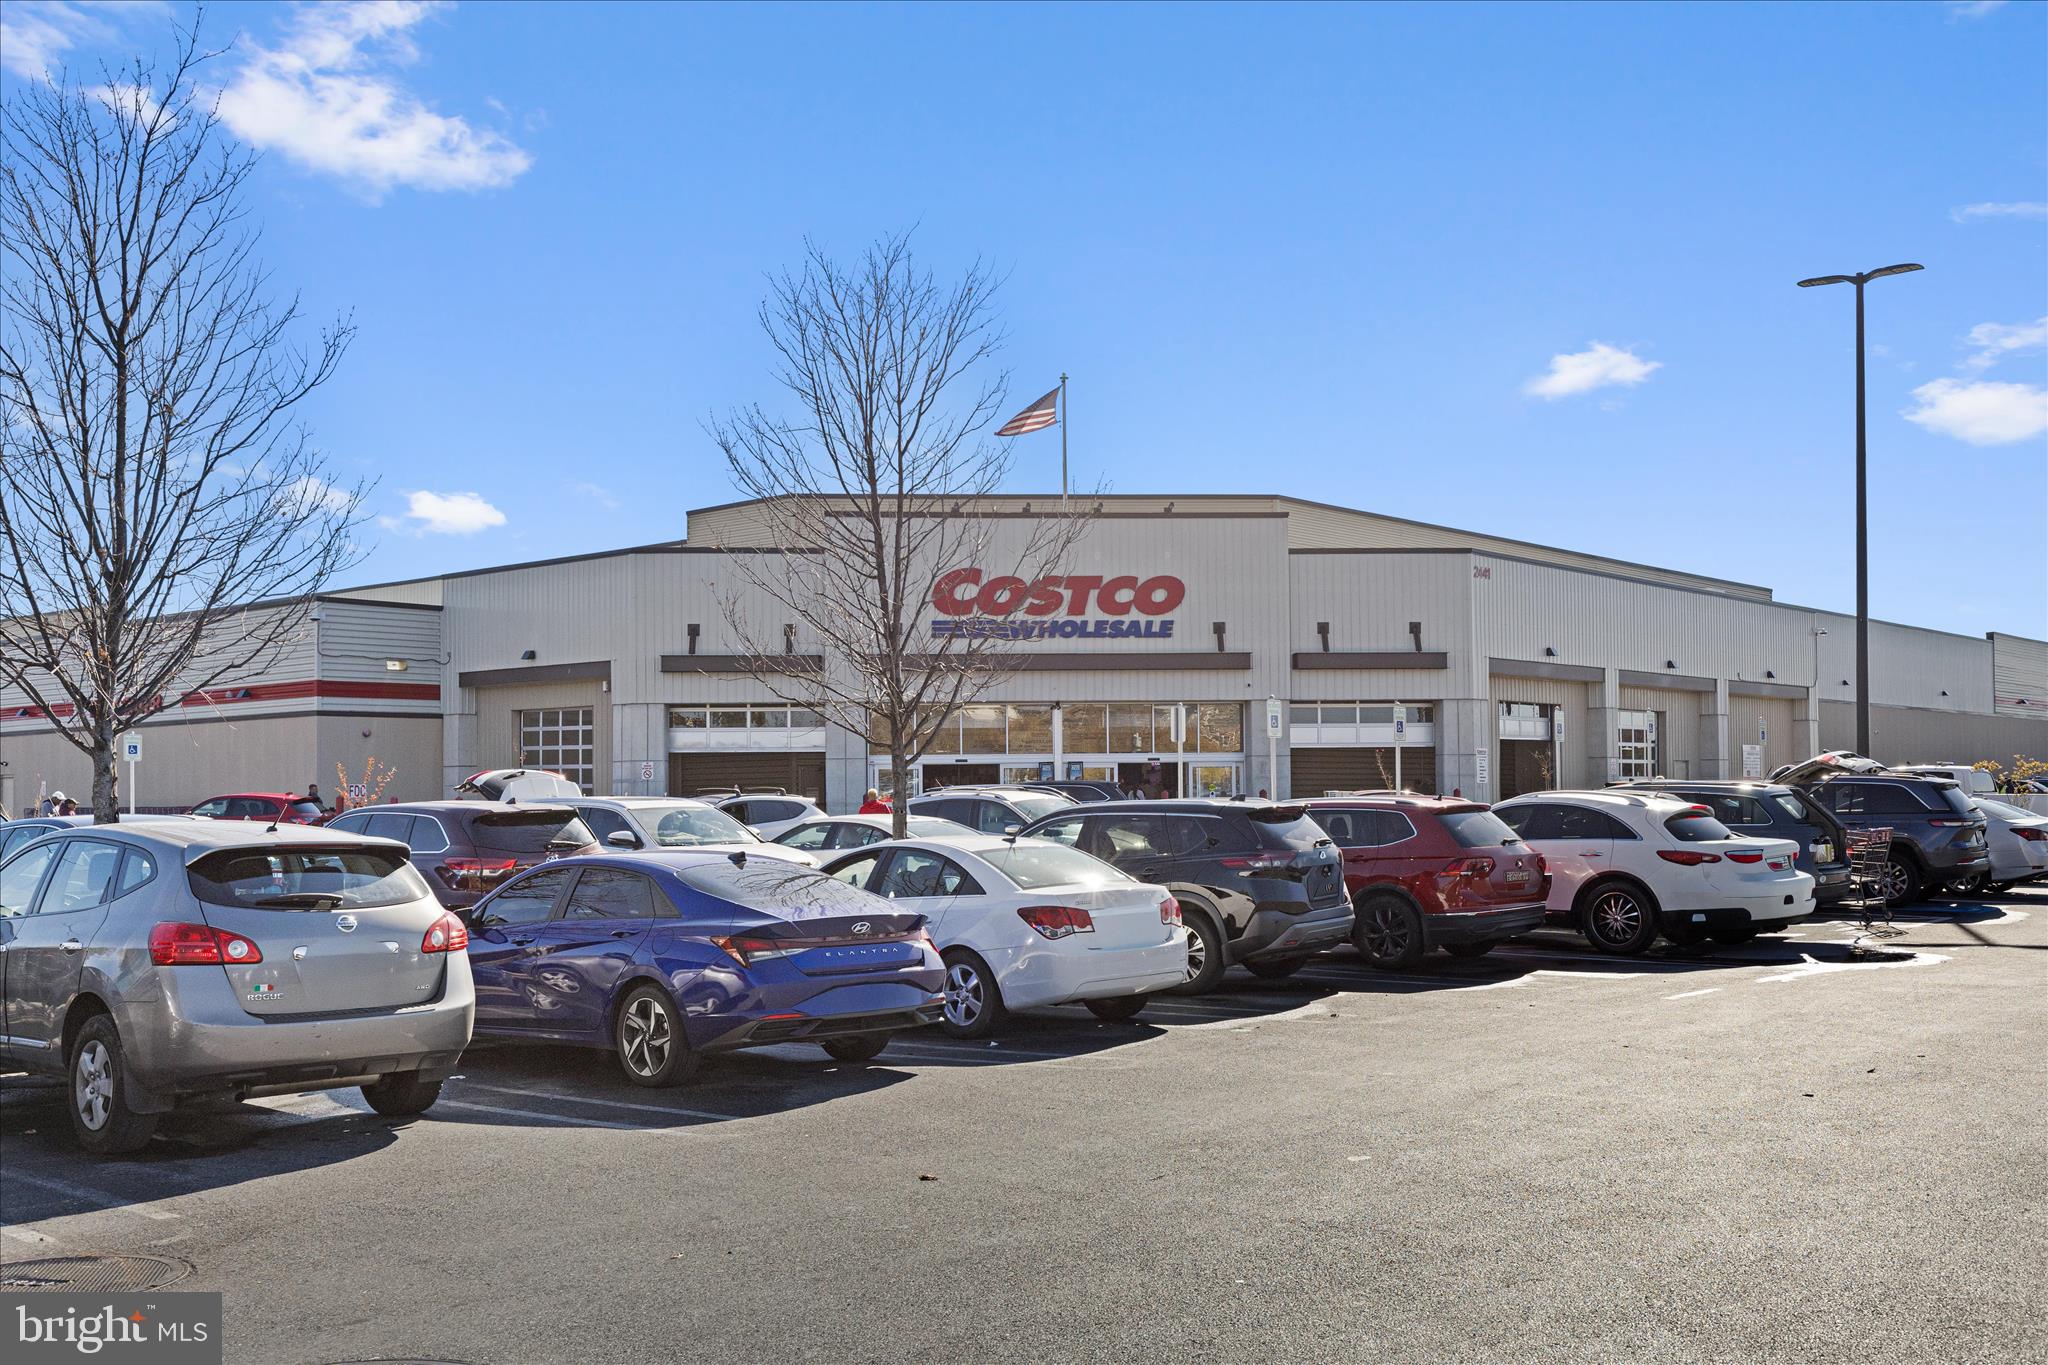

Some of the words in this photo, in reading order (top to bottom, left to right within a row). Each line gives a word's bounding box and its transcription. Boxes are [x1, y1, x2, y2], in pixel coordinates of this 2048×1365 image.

[931, 567, 1186, 616] COSTCO
[1008, 619, 1175, 639] WHOLESALE
[349, 784, 366, 798] FDC
[825, 947, 898, 958] ELANTRA
[247, 992, 286, 1001] ROGUE
